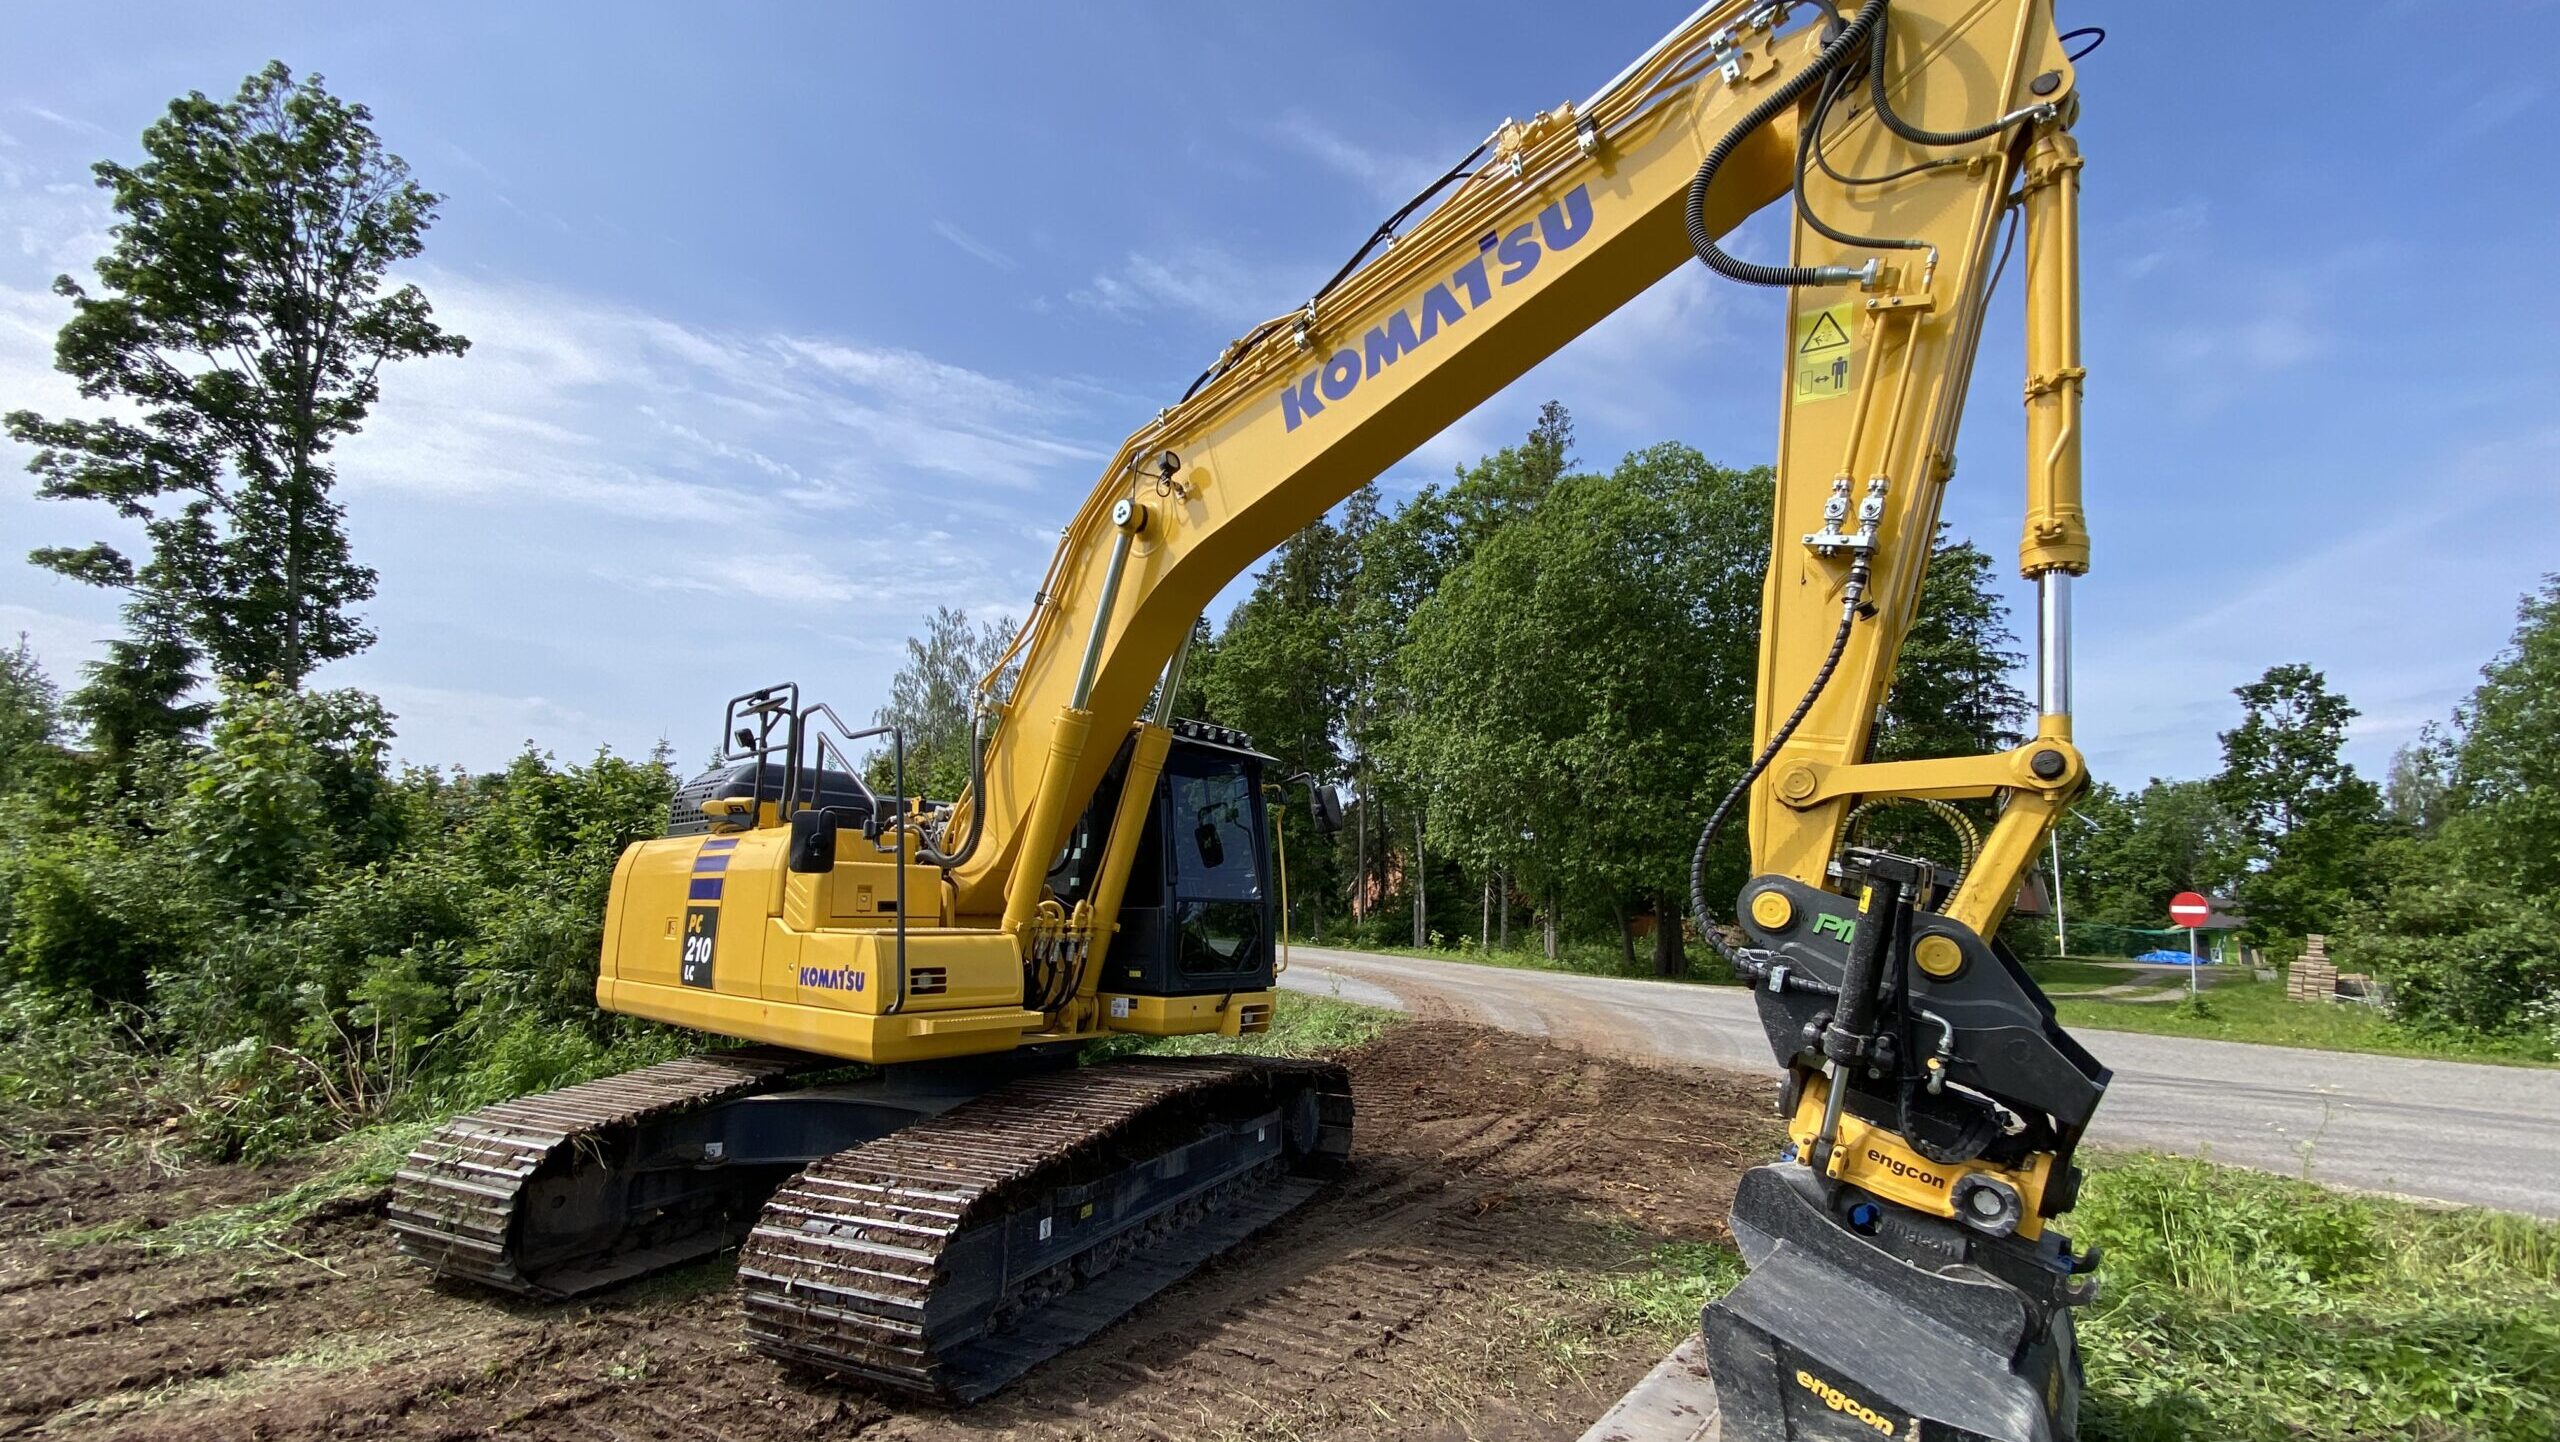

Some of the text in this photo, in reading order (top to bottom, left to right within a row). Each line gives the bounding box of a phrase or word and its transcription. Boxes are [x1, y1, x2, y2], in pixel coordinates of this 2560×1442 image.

[1280, 182, 1595, 434] KOMATSU
[688, 914, 704, 933] PC
[684, 936, 712, 964] 210
[684, 964, 695, 981] LC
[799, 964, 865, 993] KOMATSU
[1867, 1149, 1946, 1189] engcon
[1796, 1369, 1894, 1437] engcon
